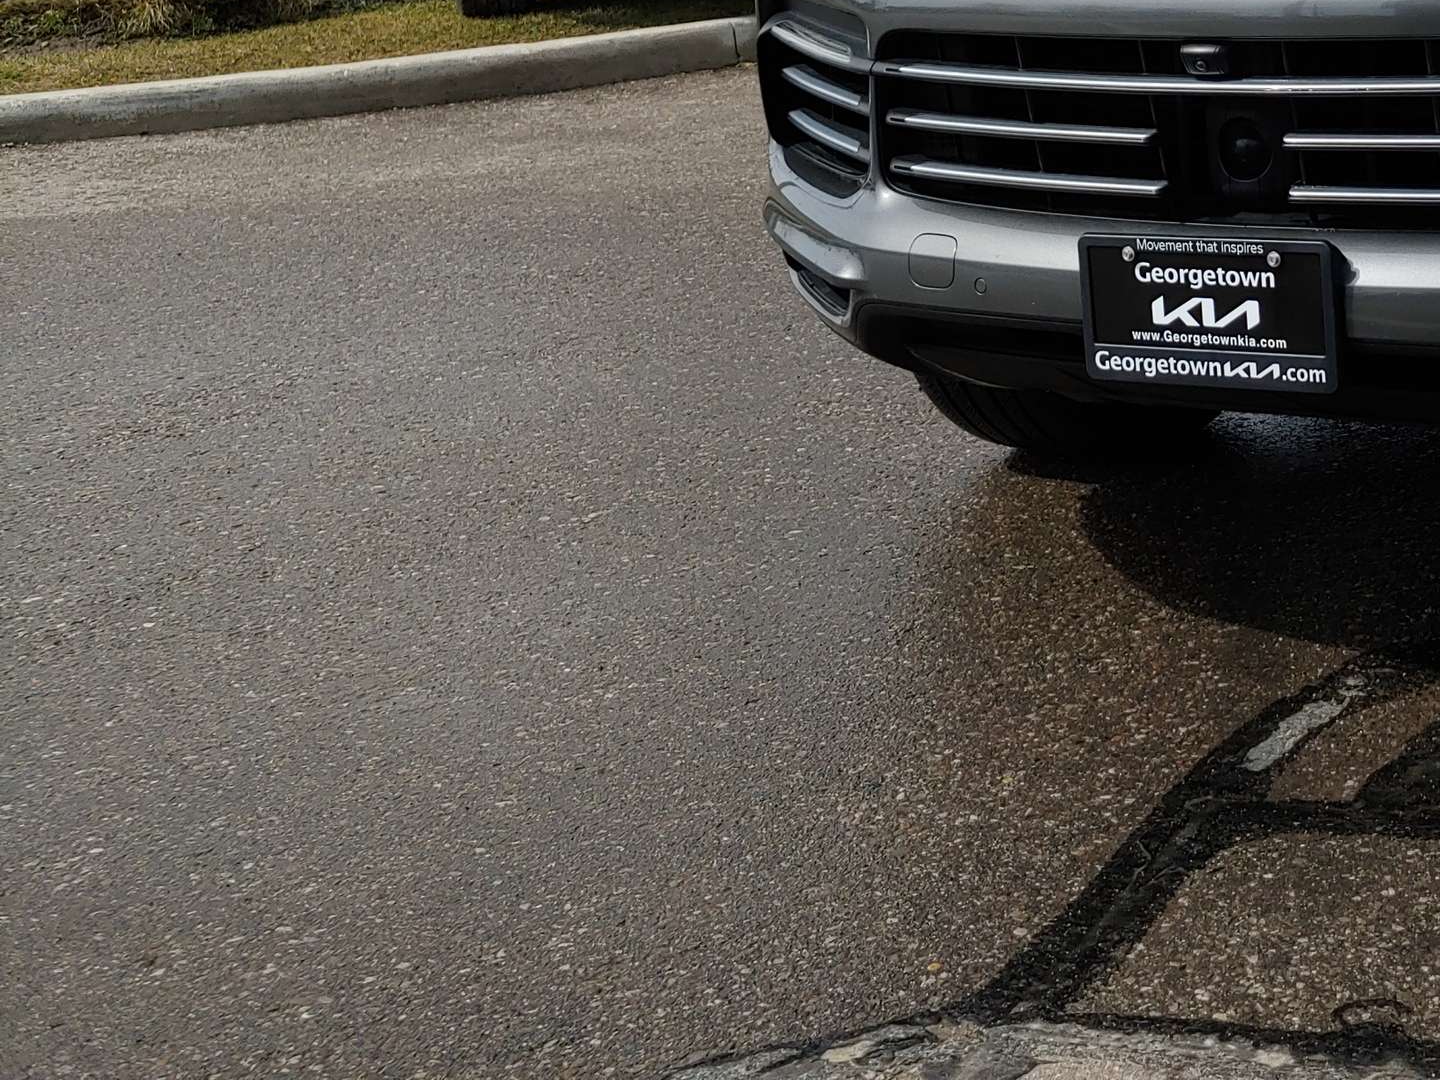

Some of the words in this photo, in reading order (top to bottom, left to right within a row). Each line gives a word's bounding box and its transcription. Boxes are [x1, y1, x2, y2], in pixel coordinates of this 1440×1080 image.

[1136, 238, 1194, 252] Movement
[1195, 240, 1218, 254] that
[1220, 240, 1264, 256] inspires
[1134, 261, 1276, 289] Georgetown
[1152, 295, 1261, 330] KIA
[1131, 329, 1288, 349] www.Georgetownkia.com
